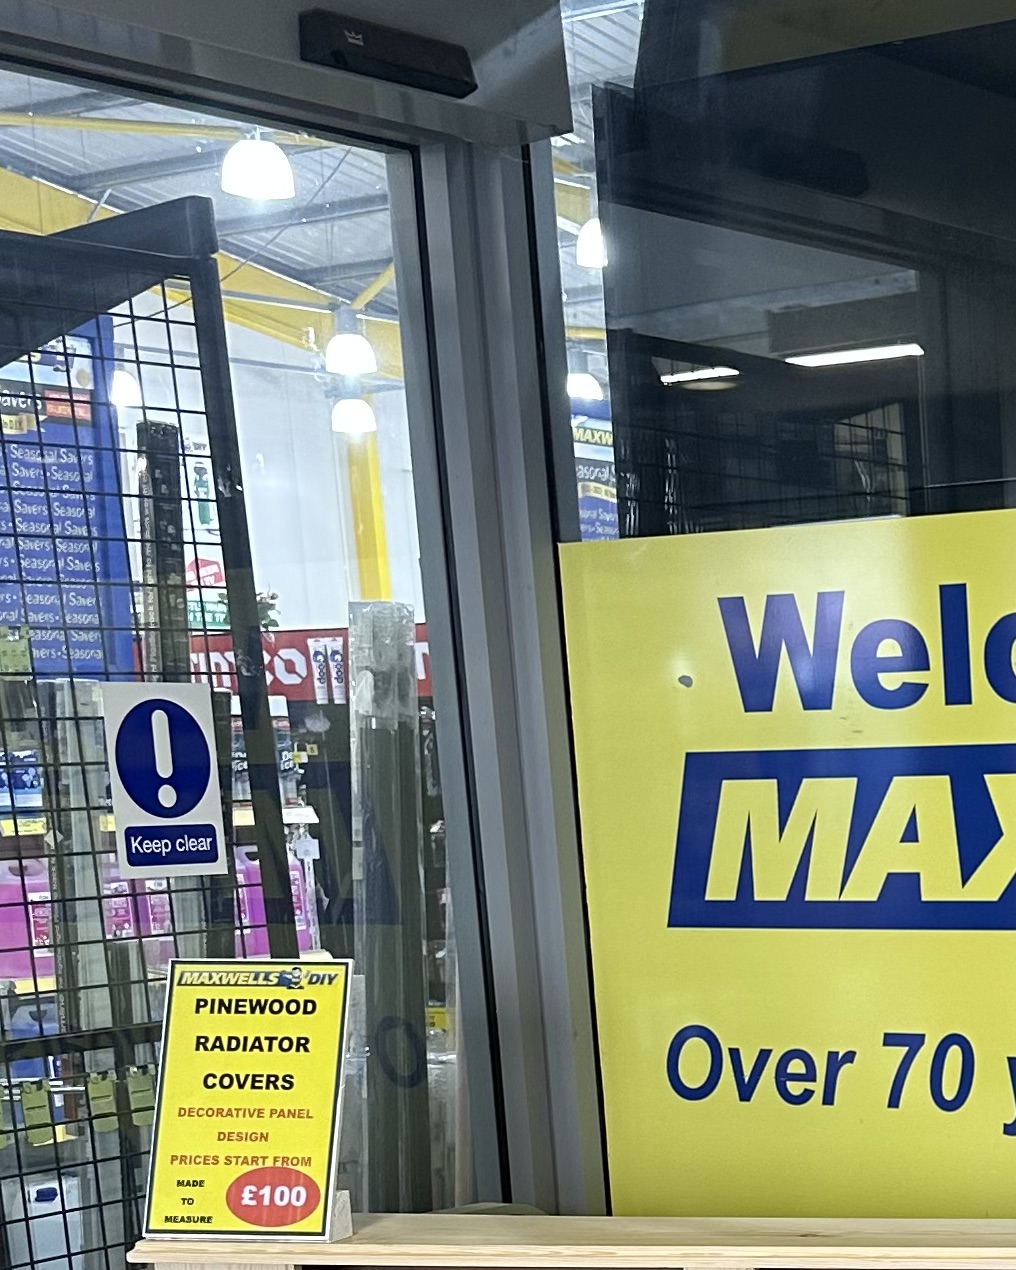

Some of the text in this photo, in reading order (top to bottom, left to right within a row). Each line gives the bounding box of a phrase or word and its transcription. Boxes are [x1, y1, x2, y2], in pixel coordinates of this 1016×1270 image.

[60, 448, 94, 465] Savrs
[64, 520, 97, 537] Saves
[67, 556, 100, 572] Saves
[21, 607, 55, 623] avers
[131, 836, 212, 857] Keep clear
[181, 971, 339, 987] MAXWELLS DIY
[195, 998, 318, 1016] PINEWOOD
[195, 1036, 311, 1053] RADIATOR
[665, 1025, 856, 1107] Over
[881, 1032, 975, 1112] 70
[203, 1073, 295, 1091] COVERS
[178, 1107, 314, 1119] DECORATIVE PANEL
[217, 1131, 269, 1143] DESIGN
[170, 1155, 312, 1167] PRICES START FROM
[177, 1179, 205, 1188] MADE
[181, 1198, 194, 1206] TO
[241, 1185, 307, 1207] £100
[164, 1216, 213, 1225] MEASURE
